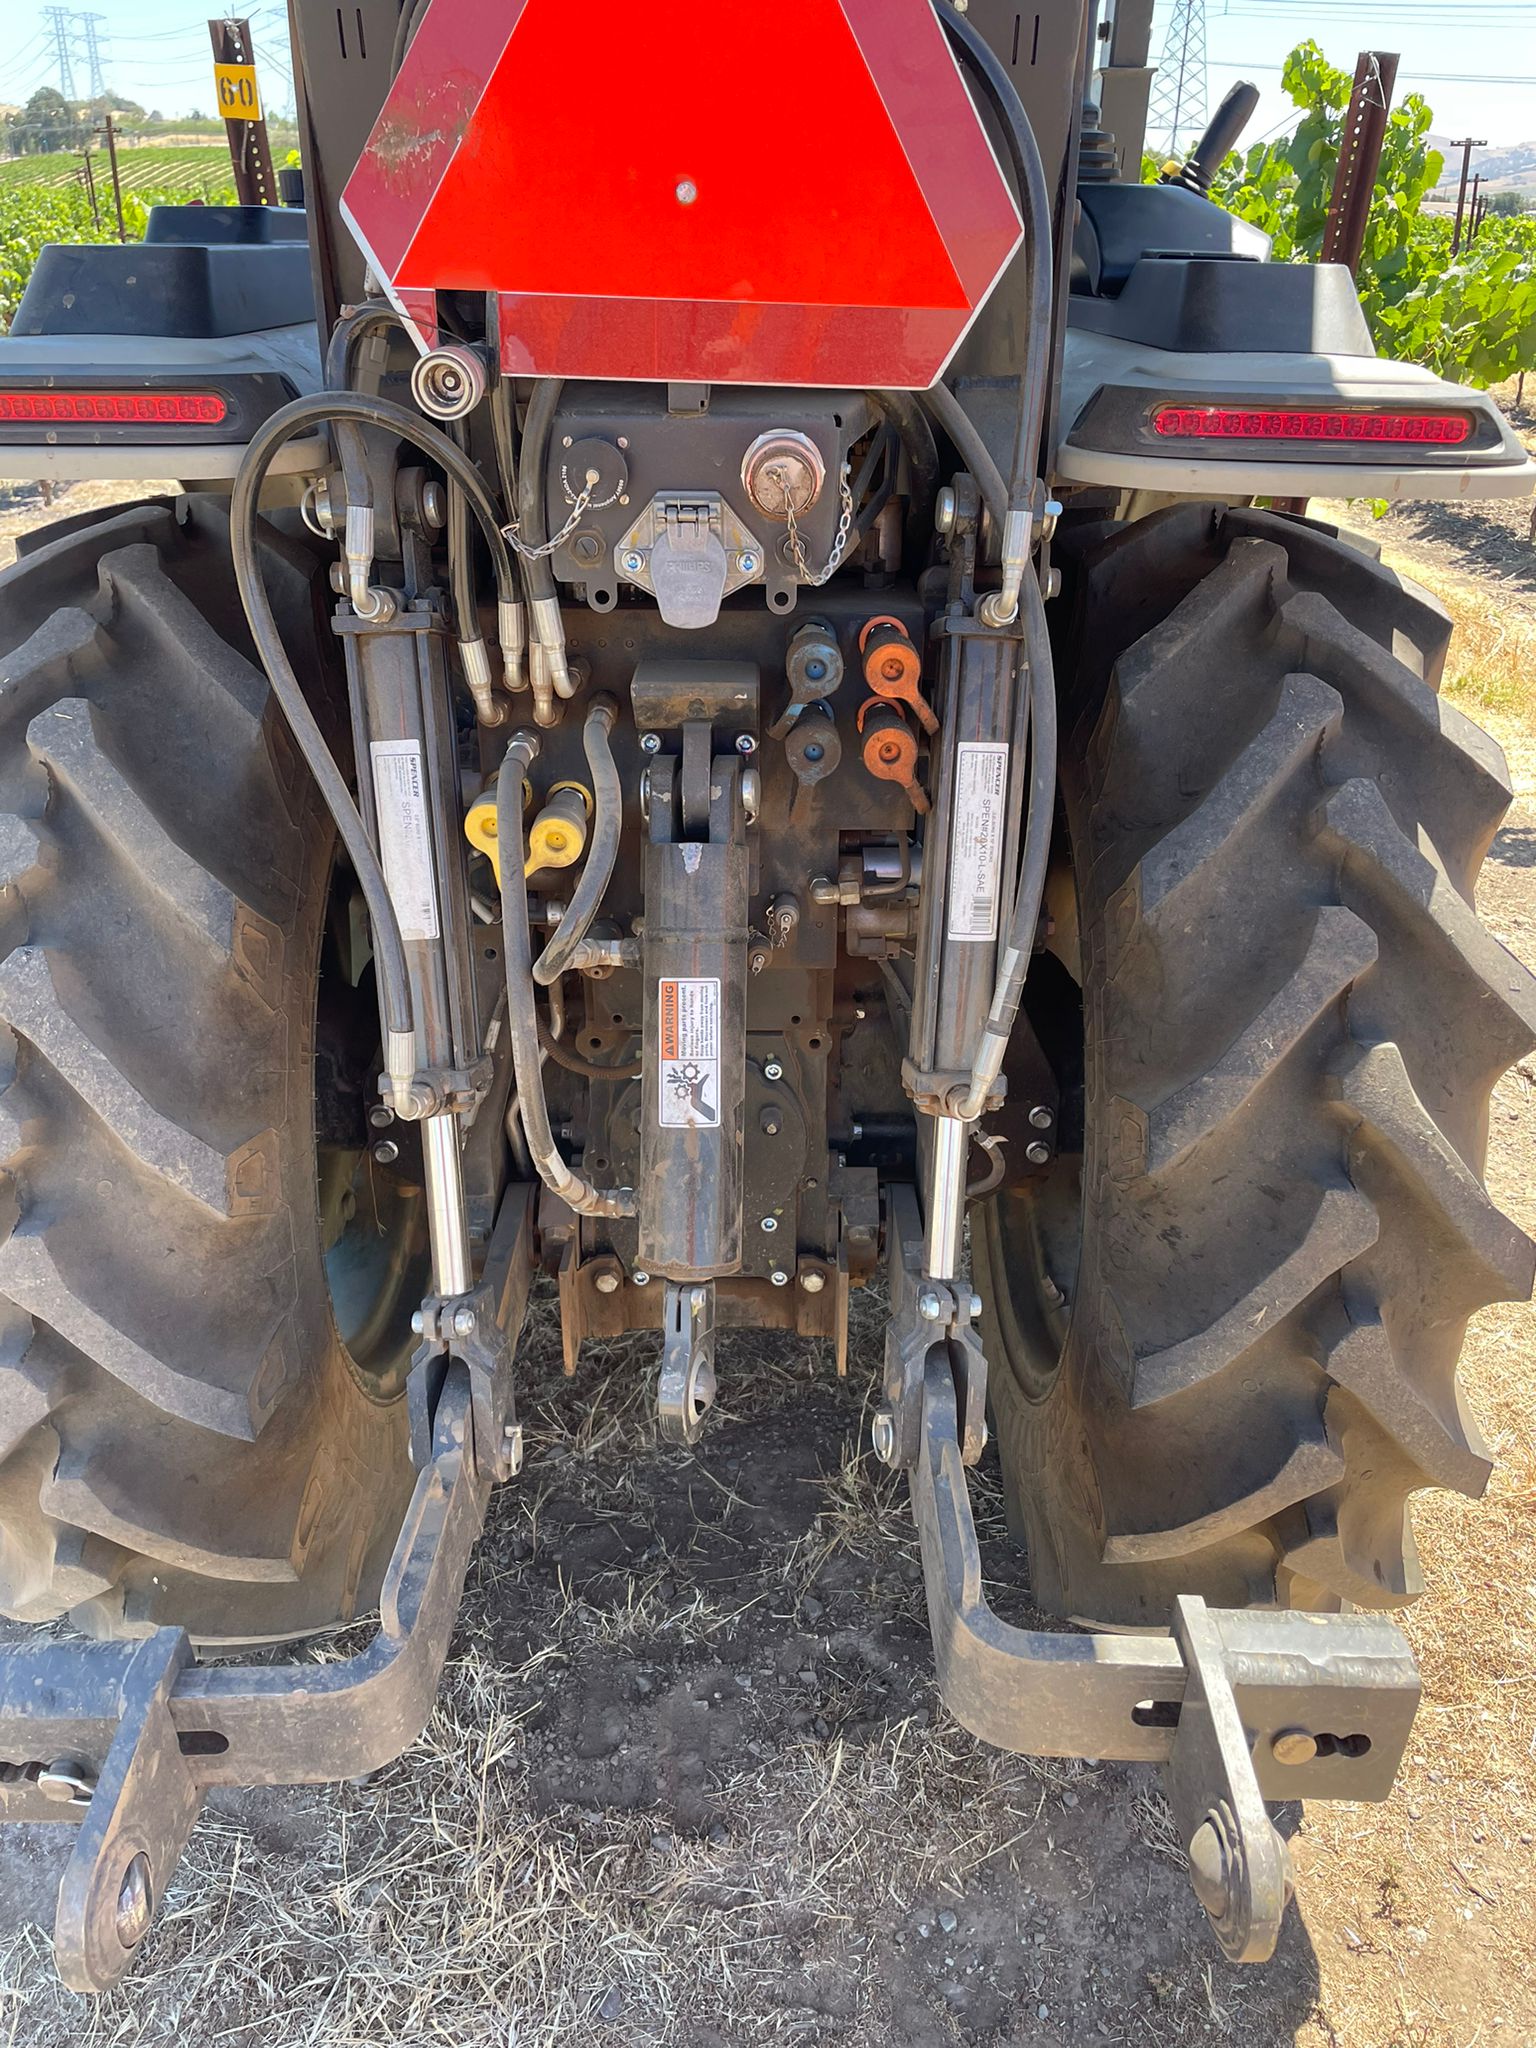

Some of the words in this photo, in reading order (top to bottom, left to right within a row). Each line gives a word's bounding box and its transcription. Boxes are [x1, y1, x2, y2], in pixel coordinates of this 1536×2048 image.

[220, 77, 254, 106] 60
[410, 757, 420, 798] SPENCER
[994, 755, 1003, 796] SPENCER
[665, 985, 674, 1044] WARNING
